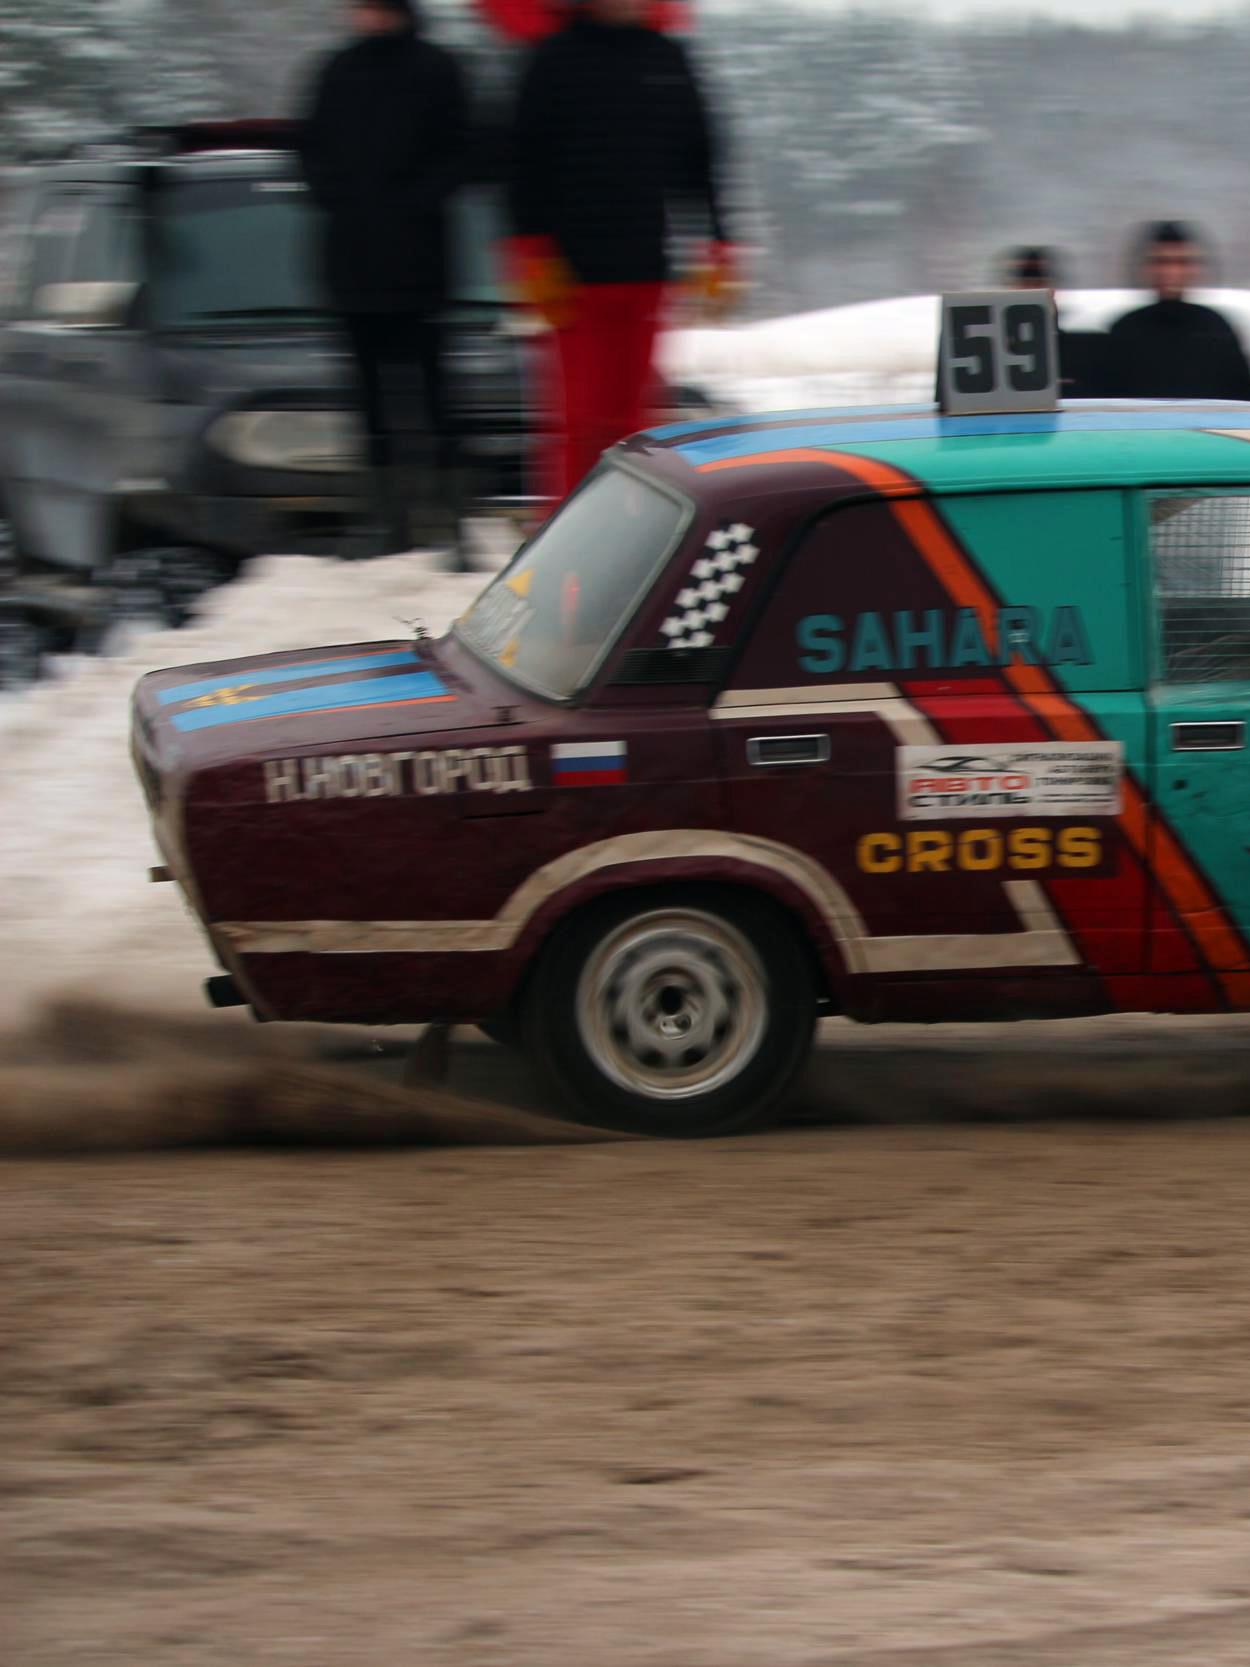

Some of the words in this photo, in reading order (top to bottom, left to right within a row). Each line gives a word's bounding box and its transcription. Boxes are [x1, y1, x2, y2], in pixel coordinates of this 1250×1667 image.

[948, 303, 1046, 394] 59
[796, 605, 1093, 673] SAHARA
[857, 827, 1102, 874] CROSS
